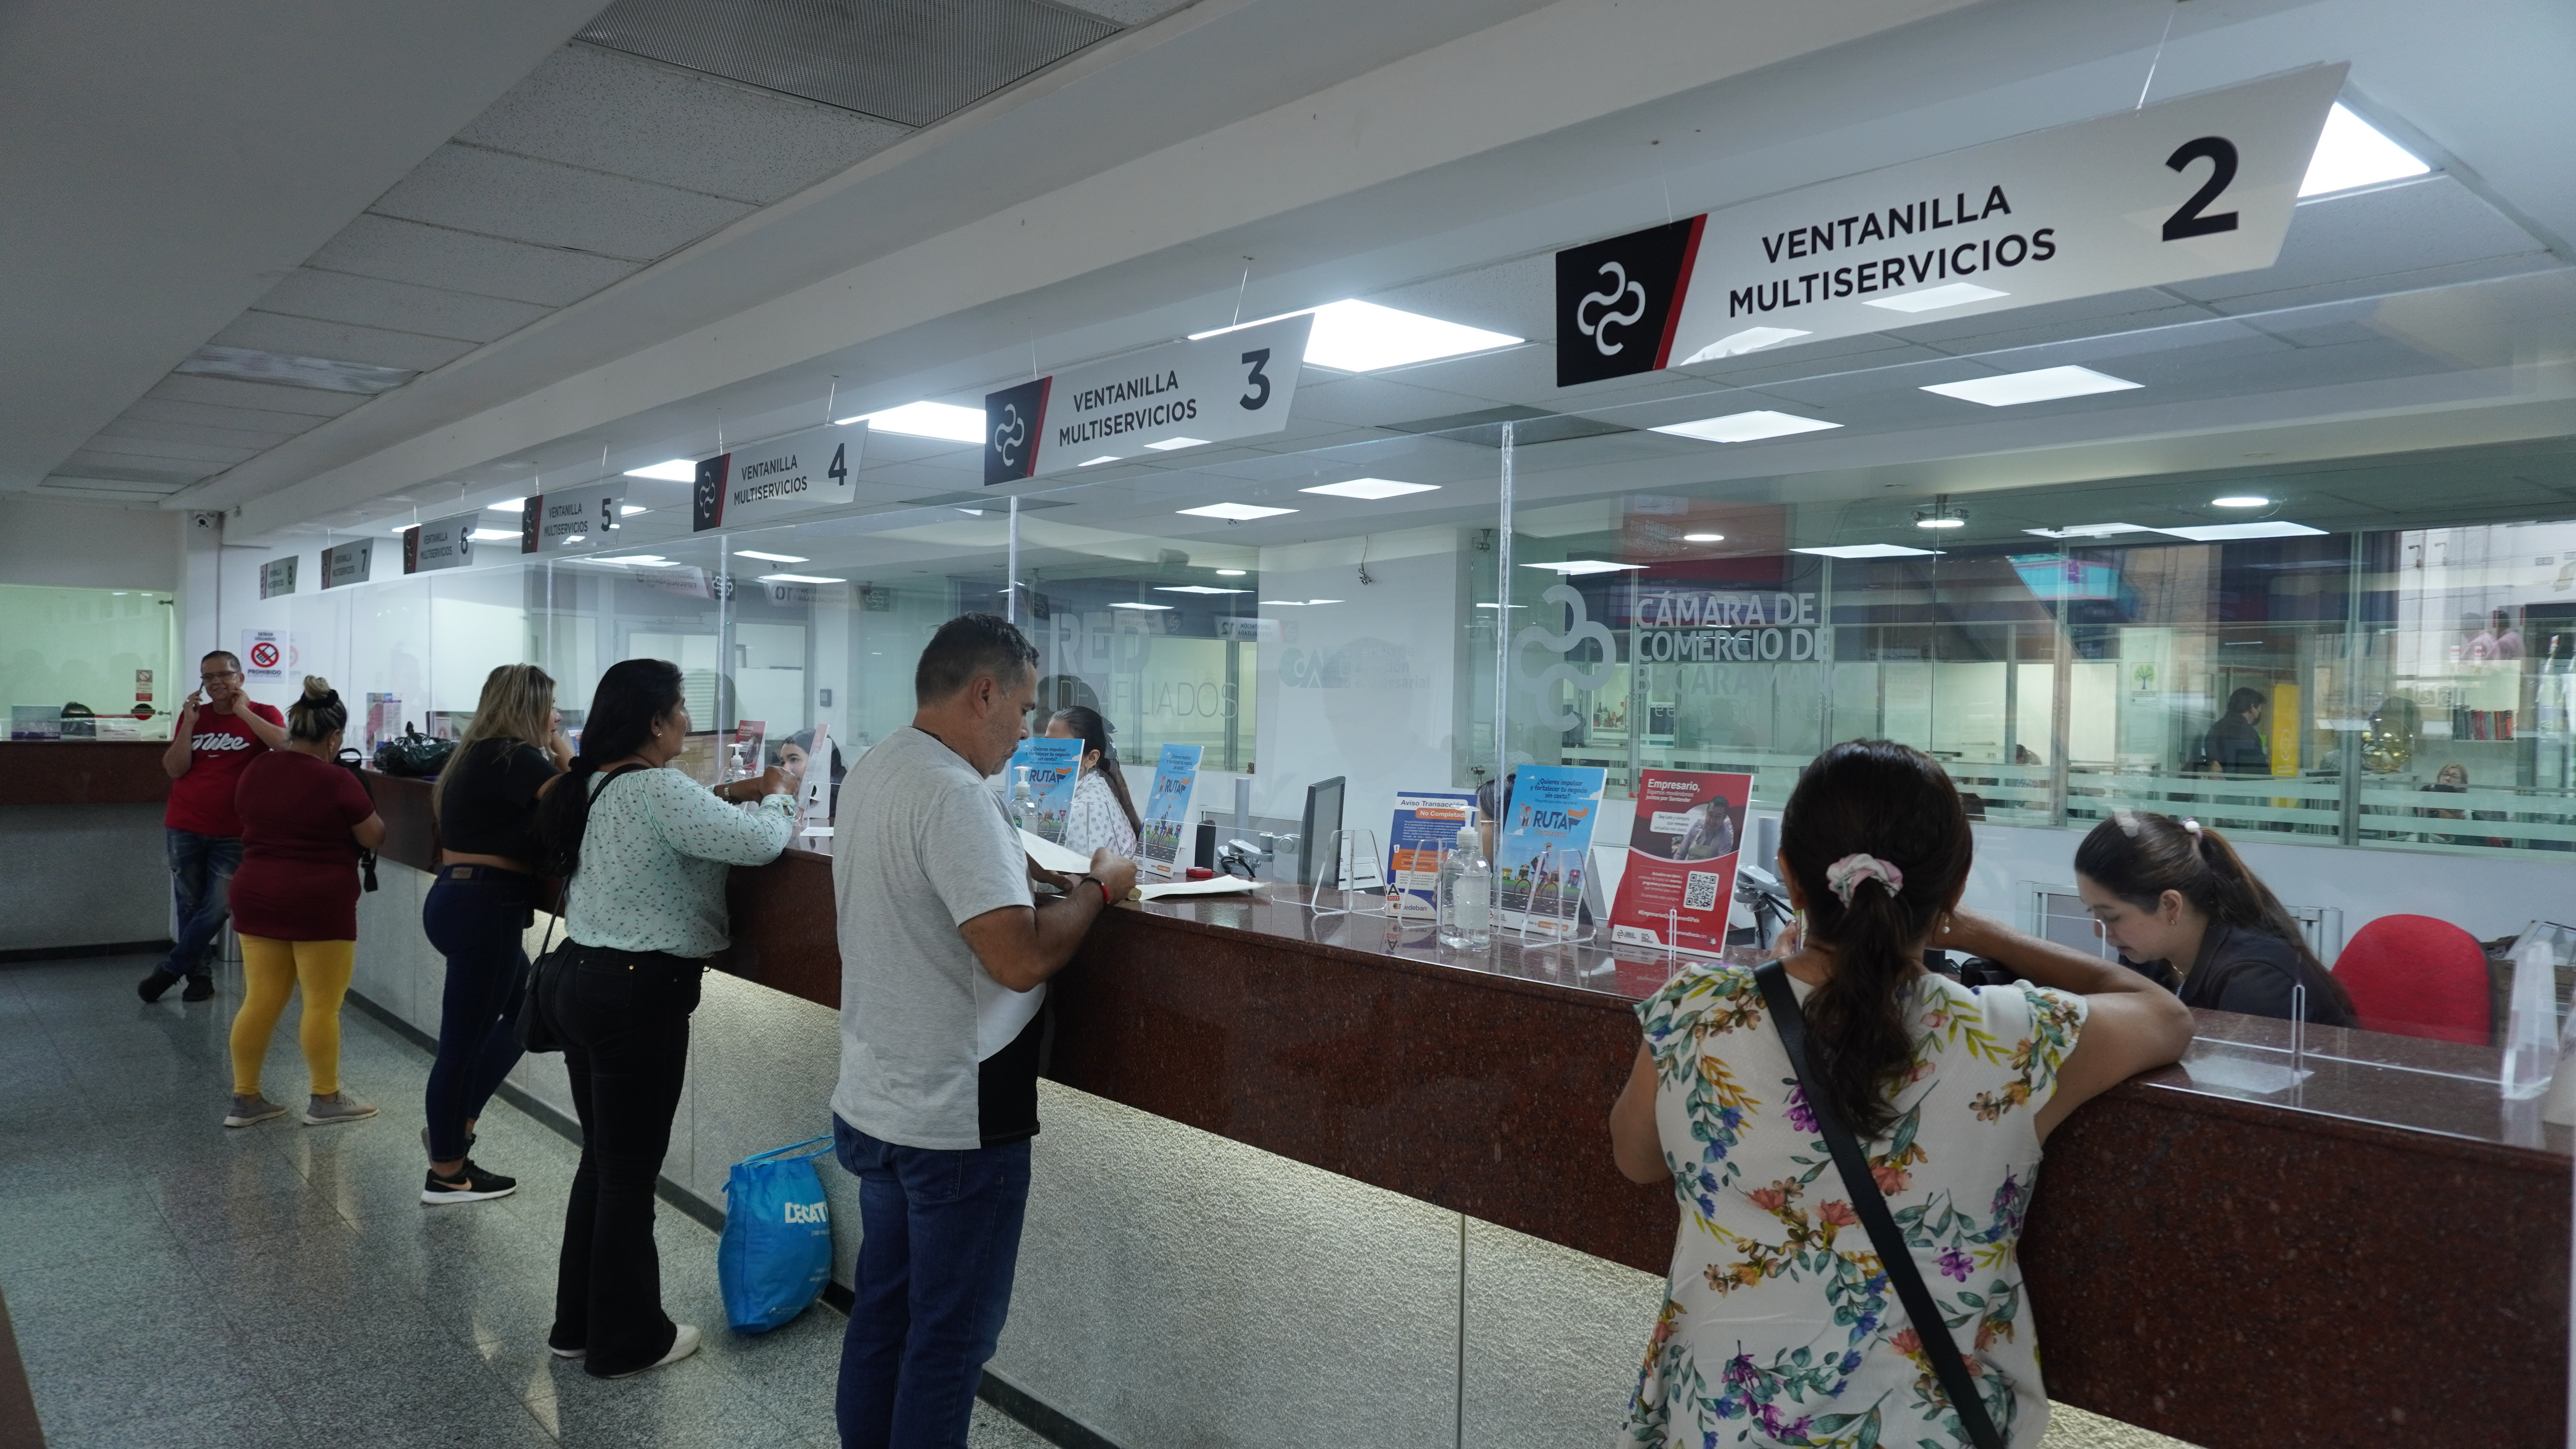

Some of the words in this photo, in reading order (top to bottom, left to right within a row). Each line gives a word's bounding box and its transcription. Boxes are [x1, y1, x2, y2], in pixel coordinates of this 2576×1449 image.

[2162, 136, 2239, 243] 2
[1762, 185, 2011, 264] VENTANILLA
[1729, 228, 2057, 318] MULTISERVICIOS
[1074, 370, 1179, 412] VENTANILLA
[1239, 348, 1270, 410] 3
[1060, 399, 1197, 447] MULTISERVICIOS
[741, 454, 798, 482] VENTANILLA
[828, 443, 848, 486] 4
[734, 476, 808, 506] MULTISERVICIOS
[548, 503, 582, 519] VENTANILLA
[601, 498, 612, 532] 5
[461, 527, 468, 555] 6
[544, 521, 588, 537] MULTISERVICIOS
[288, 565, 293, 585] 8
[361, 548, 368, 572] 7
[1636, 591, 1768, 627] CÁMARA
[1775, 592, 1815, 625] DE
[1049, 609, 1151, 713] RED
[1637, 629, 1783, 661] COMERCIO
[1791, 628, 1832, 661] DE
[1636, 664, 1877, 695] BUCARAMANG
[1060, 680, 1090, 711] DE
[1097, 679, 1238, 719] AFILIADOS
[192, 733, 250, 750] Nike
[1648, 779, 1701, 792] Empresario,
